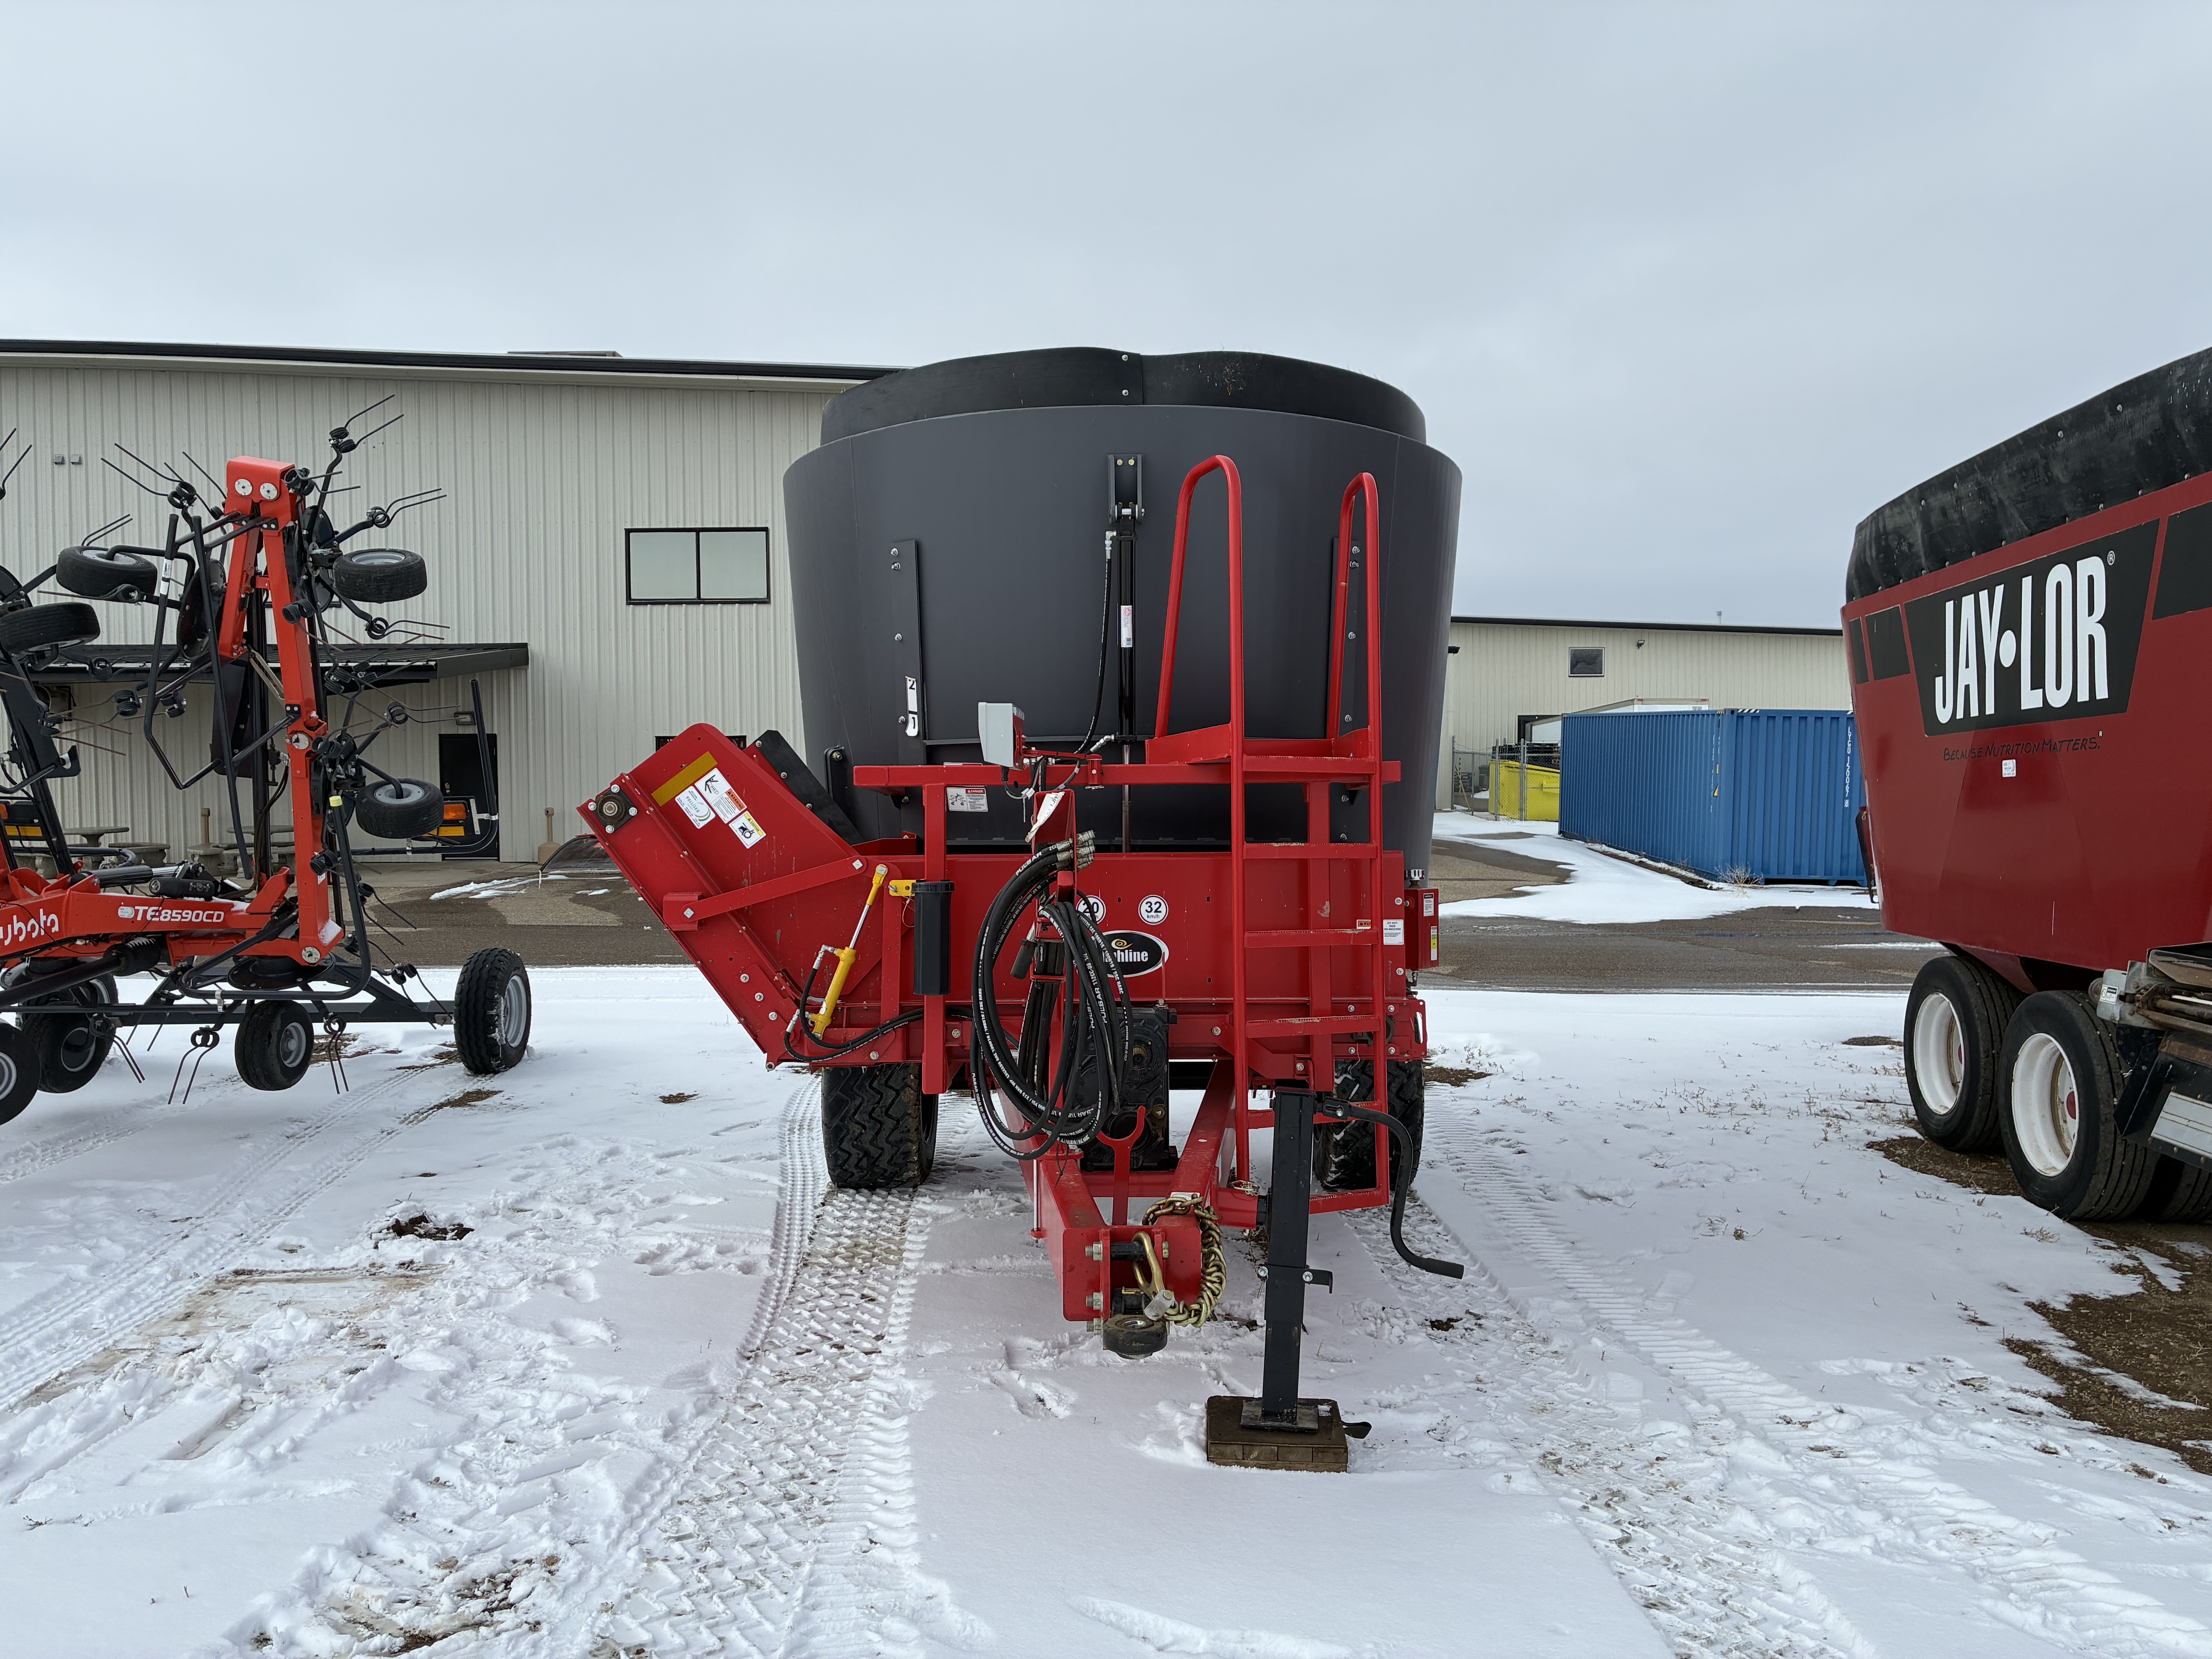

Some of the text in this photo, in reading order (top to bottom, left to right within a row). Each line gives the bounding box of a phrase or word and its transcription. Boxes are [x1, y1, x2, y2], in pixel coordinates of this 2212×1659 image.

[912, 716, 915, 729] 1
[1145, 901, 1162, 913] 32
[0, 908, 59, 946] ubota
